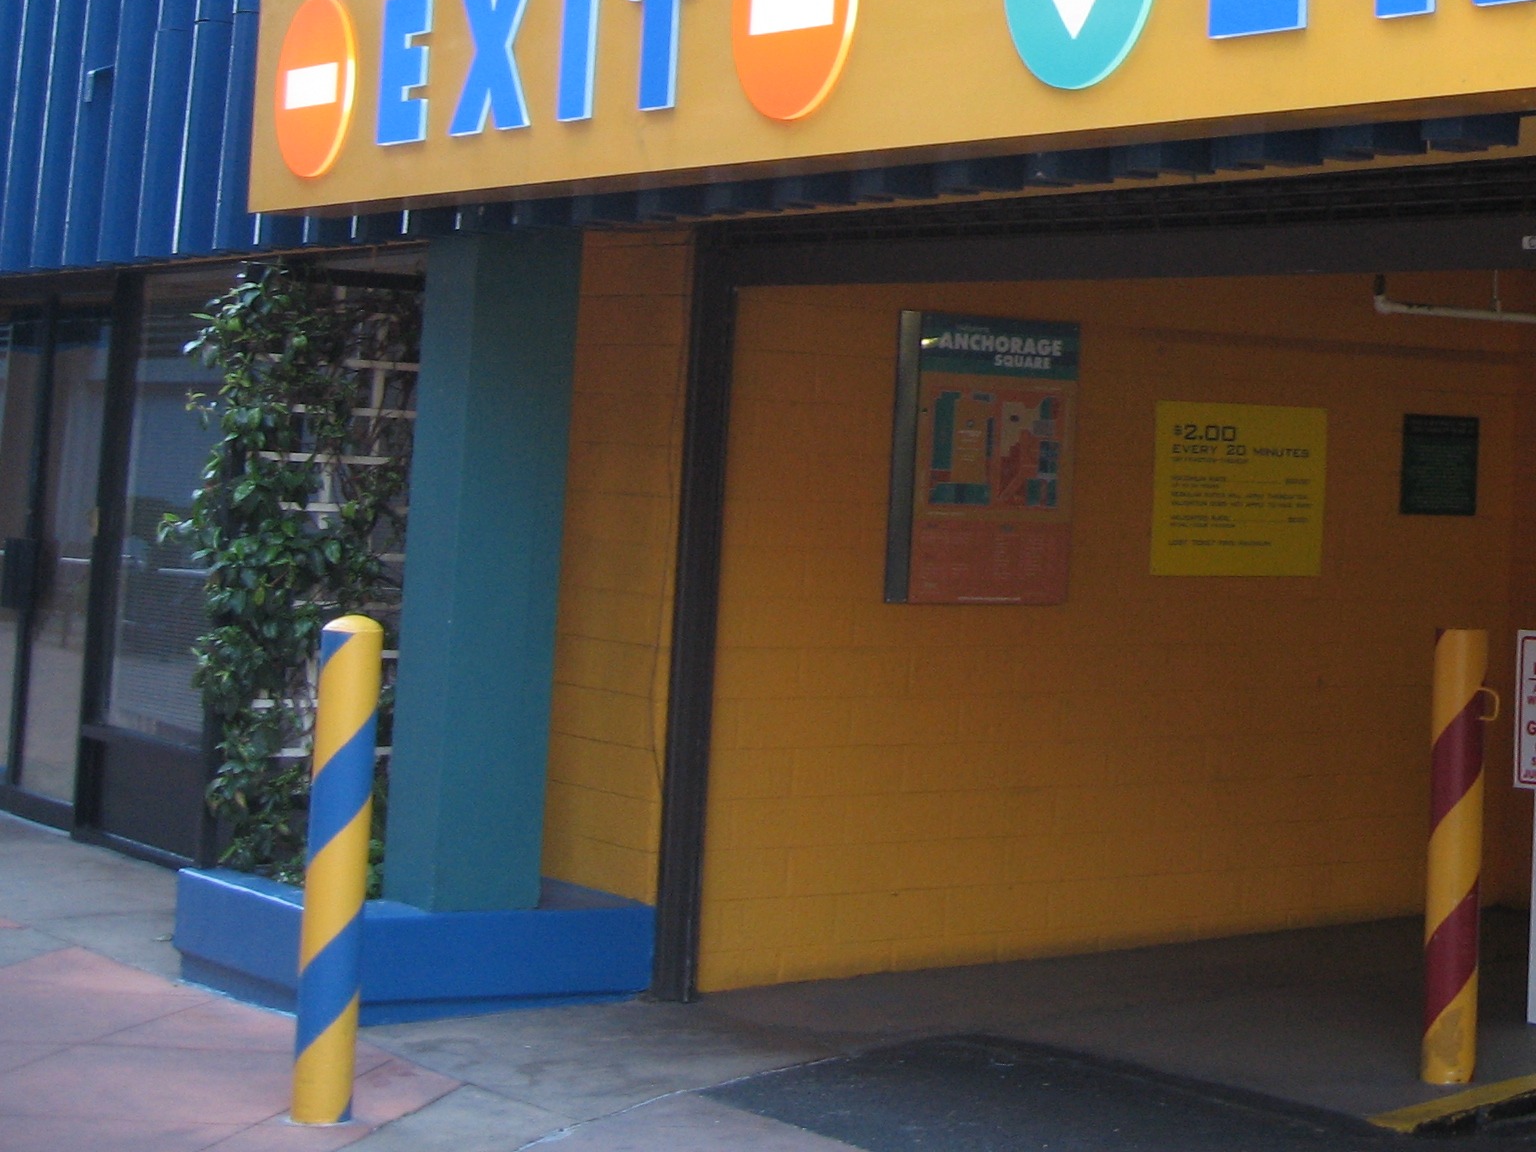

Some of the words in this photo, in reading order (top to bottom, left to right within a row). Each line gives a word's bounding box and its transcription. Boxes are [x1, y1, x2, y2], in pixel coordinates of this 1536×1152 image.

[939, 332, 1063, 356] ANCHORAGE
[994, 354, 1052, 369] SQUARE
[1174, 424, 1236, 441] $2.00
[1172, 444, 1217, 454] EVERY
[1226, 444, 1246, 456] 20
[1253, 447, 1309, 458] MINUTES
